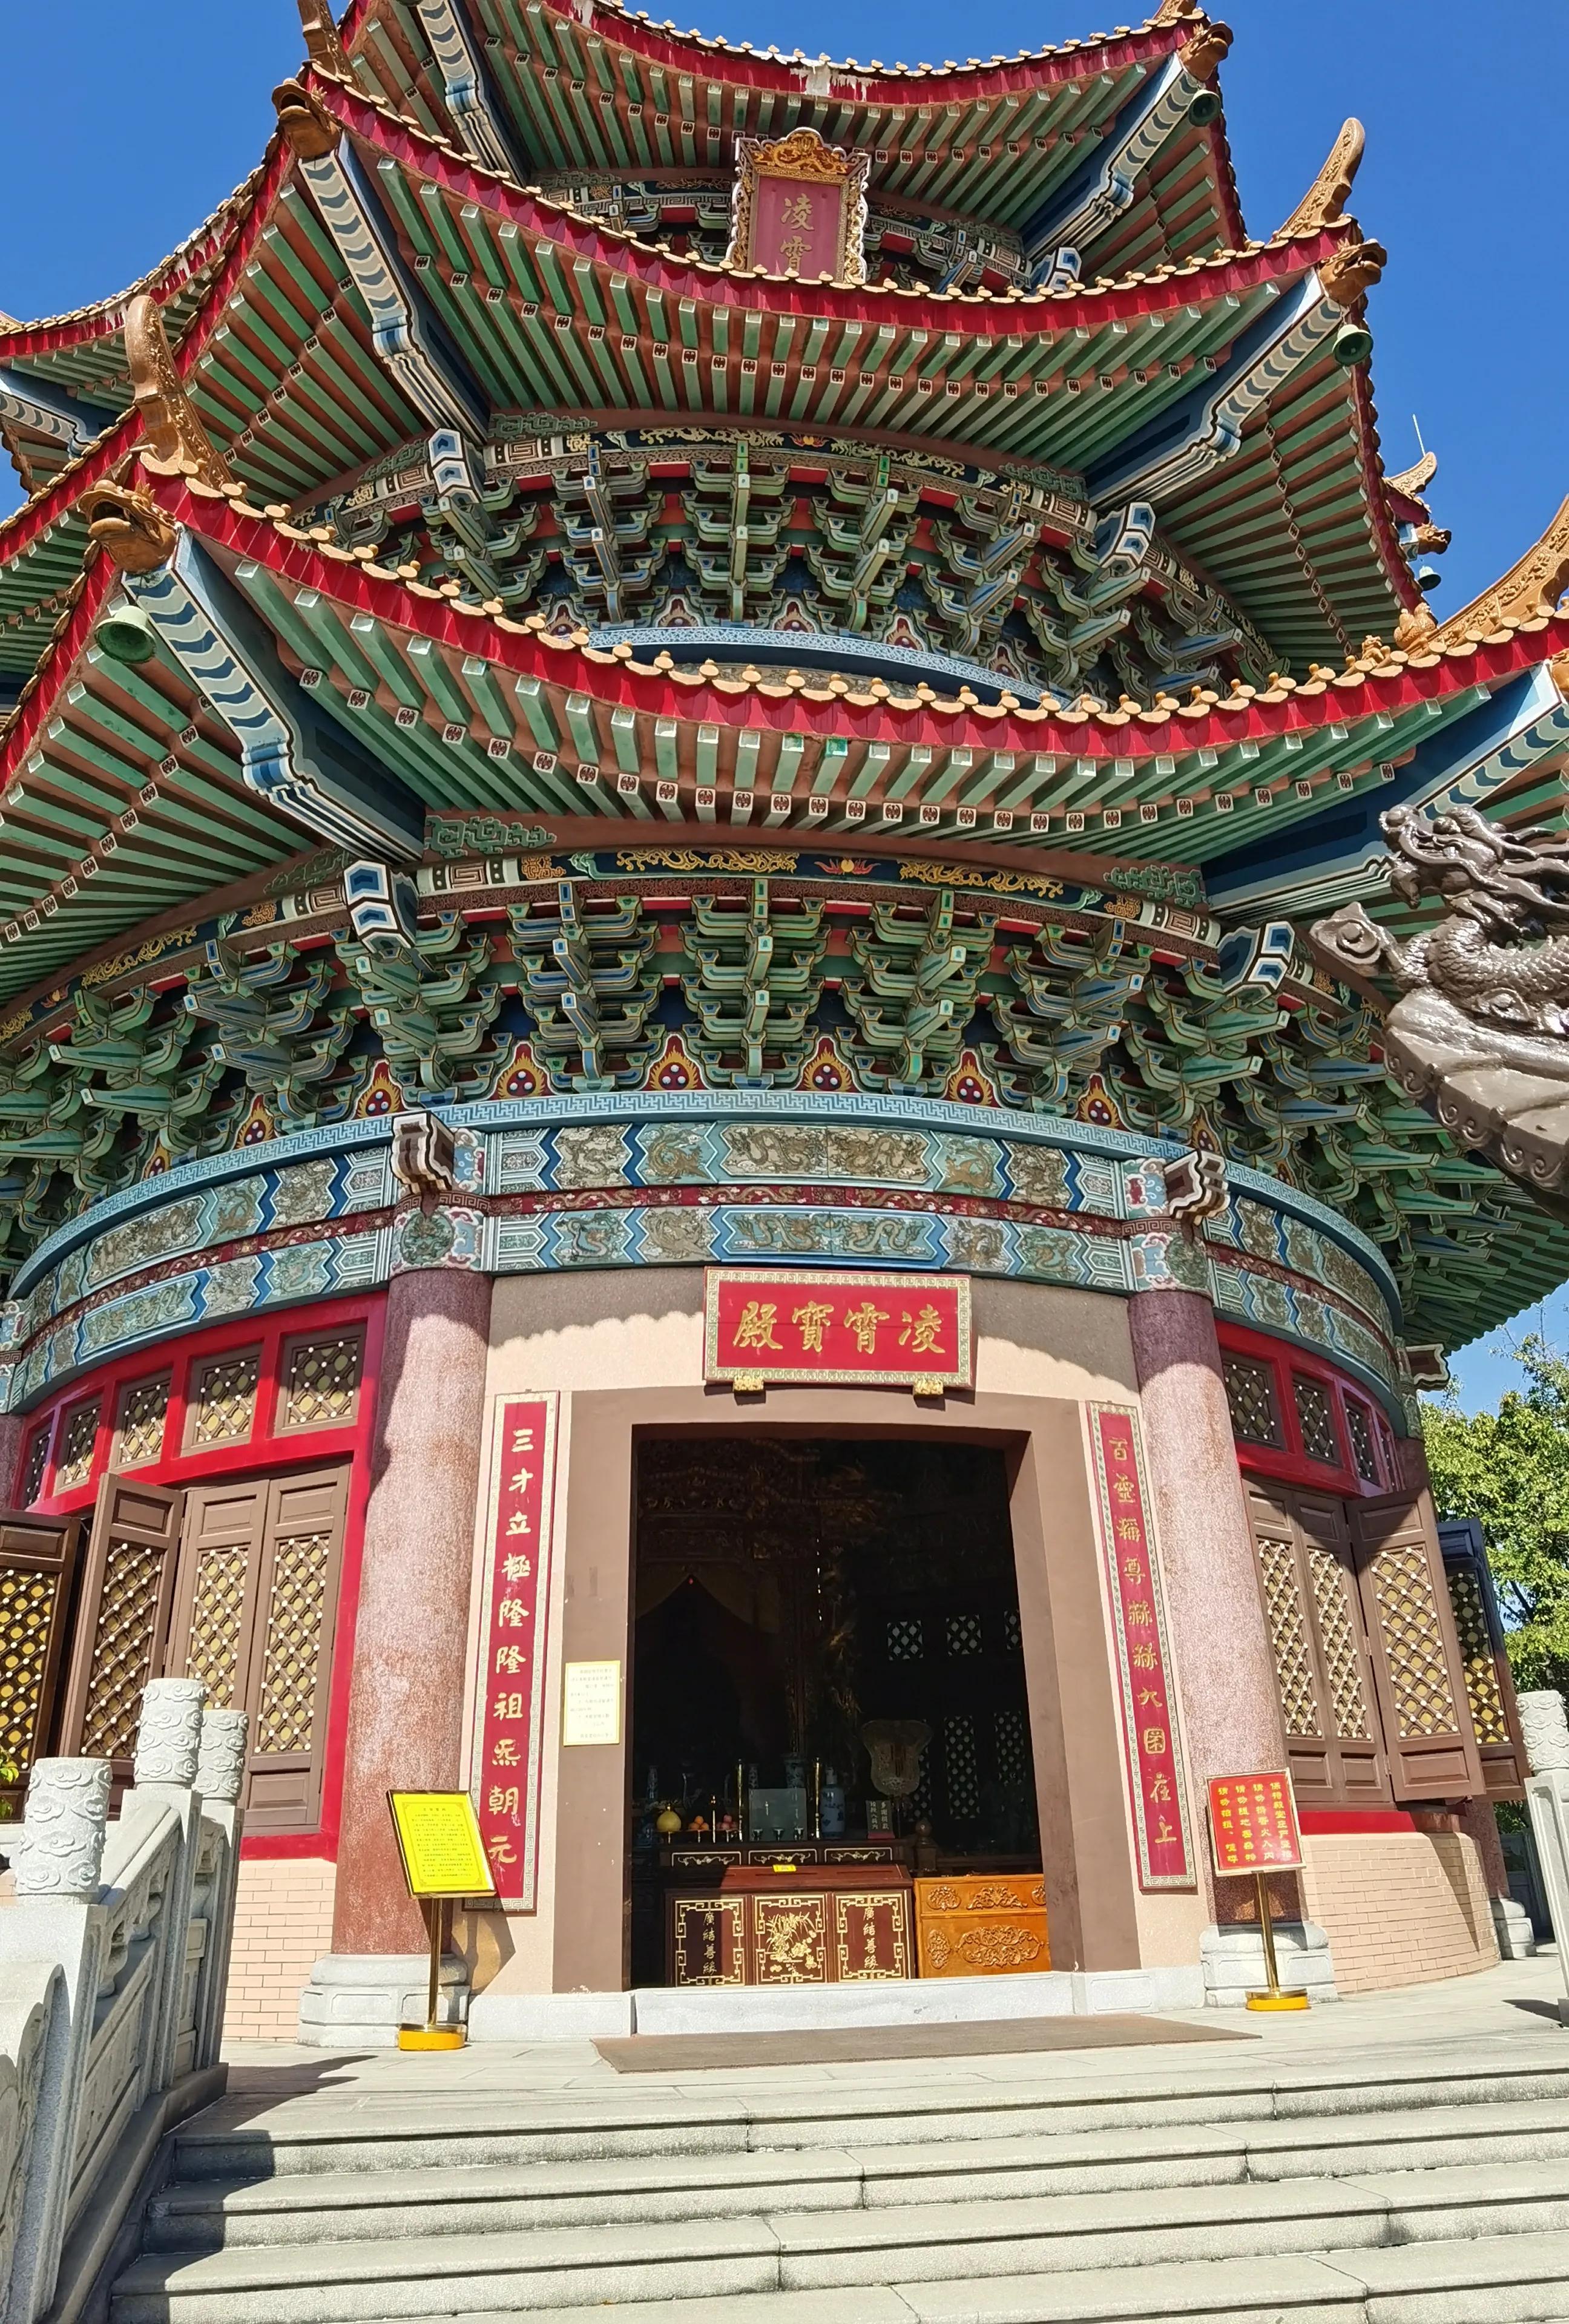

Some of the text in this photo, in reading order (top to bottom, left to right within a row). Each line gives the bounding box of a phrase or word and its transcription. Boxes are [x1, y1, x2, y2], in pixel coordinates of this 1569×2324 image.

[780, 193, 815, 272] 凌霄
[732, 1301, 946, 1355] 凌霄寶殿
[702, 1911, 717, 1975] 廣結善緣
[862, 1906, 879, 1970] 廣結善緣
